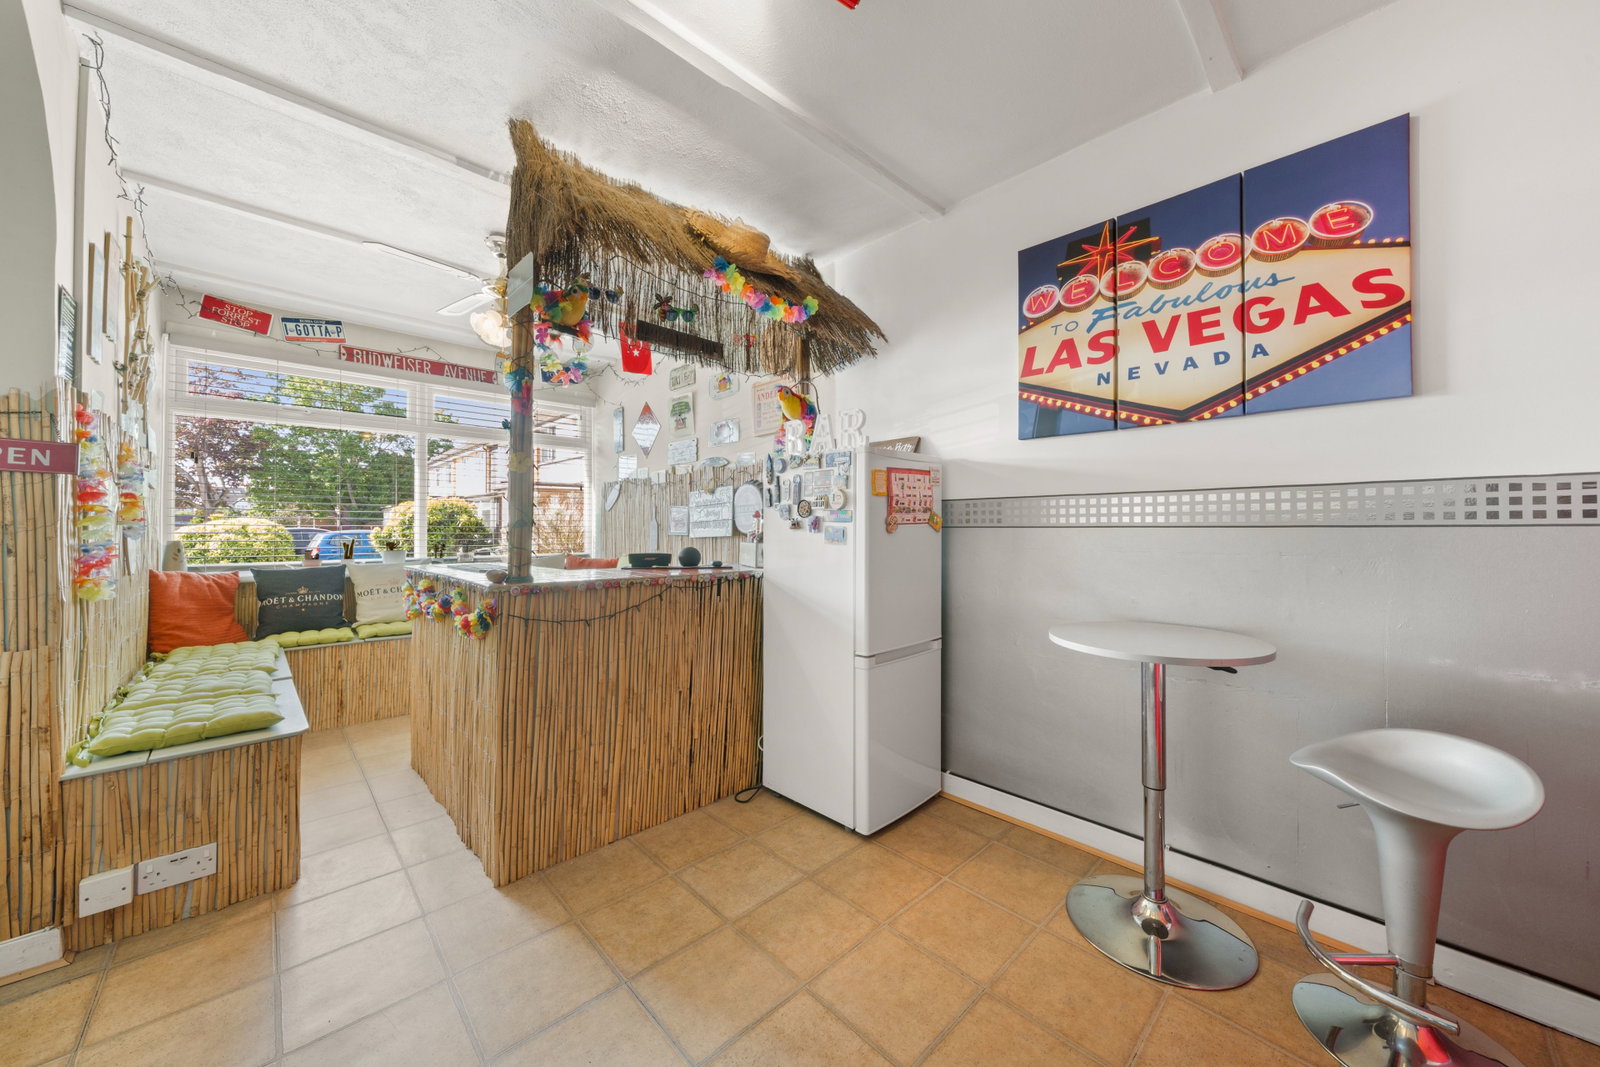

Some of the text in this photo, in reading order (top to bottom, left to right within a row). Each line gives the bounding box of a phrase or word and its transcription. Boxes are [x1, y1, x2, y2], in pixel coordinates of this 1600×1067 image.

[1029, 206, 1359, 313] WELCOME
[212, 306, 262, 326] FORREST
[224, 303, 254, 317] STOP
[1019, 267, 1406, 378] LAS VEGAS
[1050, 271, 1296, 336] TO Fabulous
[294, 323, 332, 338] GOTTA
[335, 325, 343, 338] P
[353, 348, 488, 383] BUDWEISER AVENUE
[1096, 343, 1270, 387] NEVADA
[783, 408, 869, 457] BAR
[0, 446, 51, 467] EN
